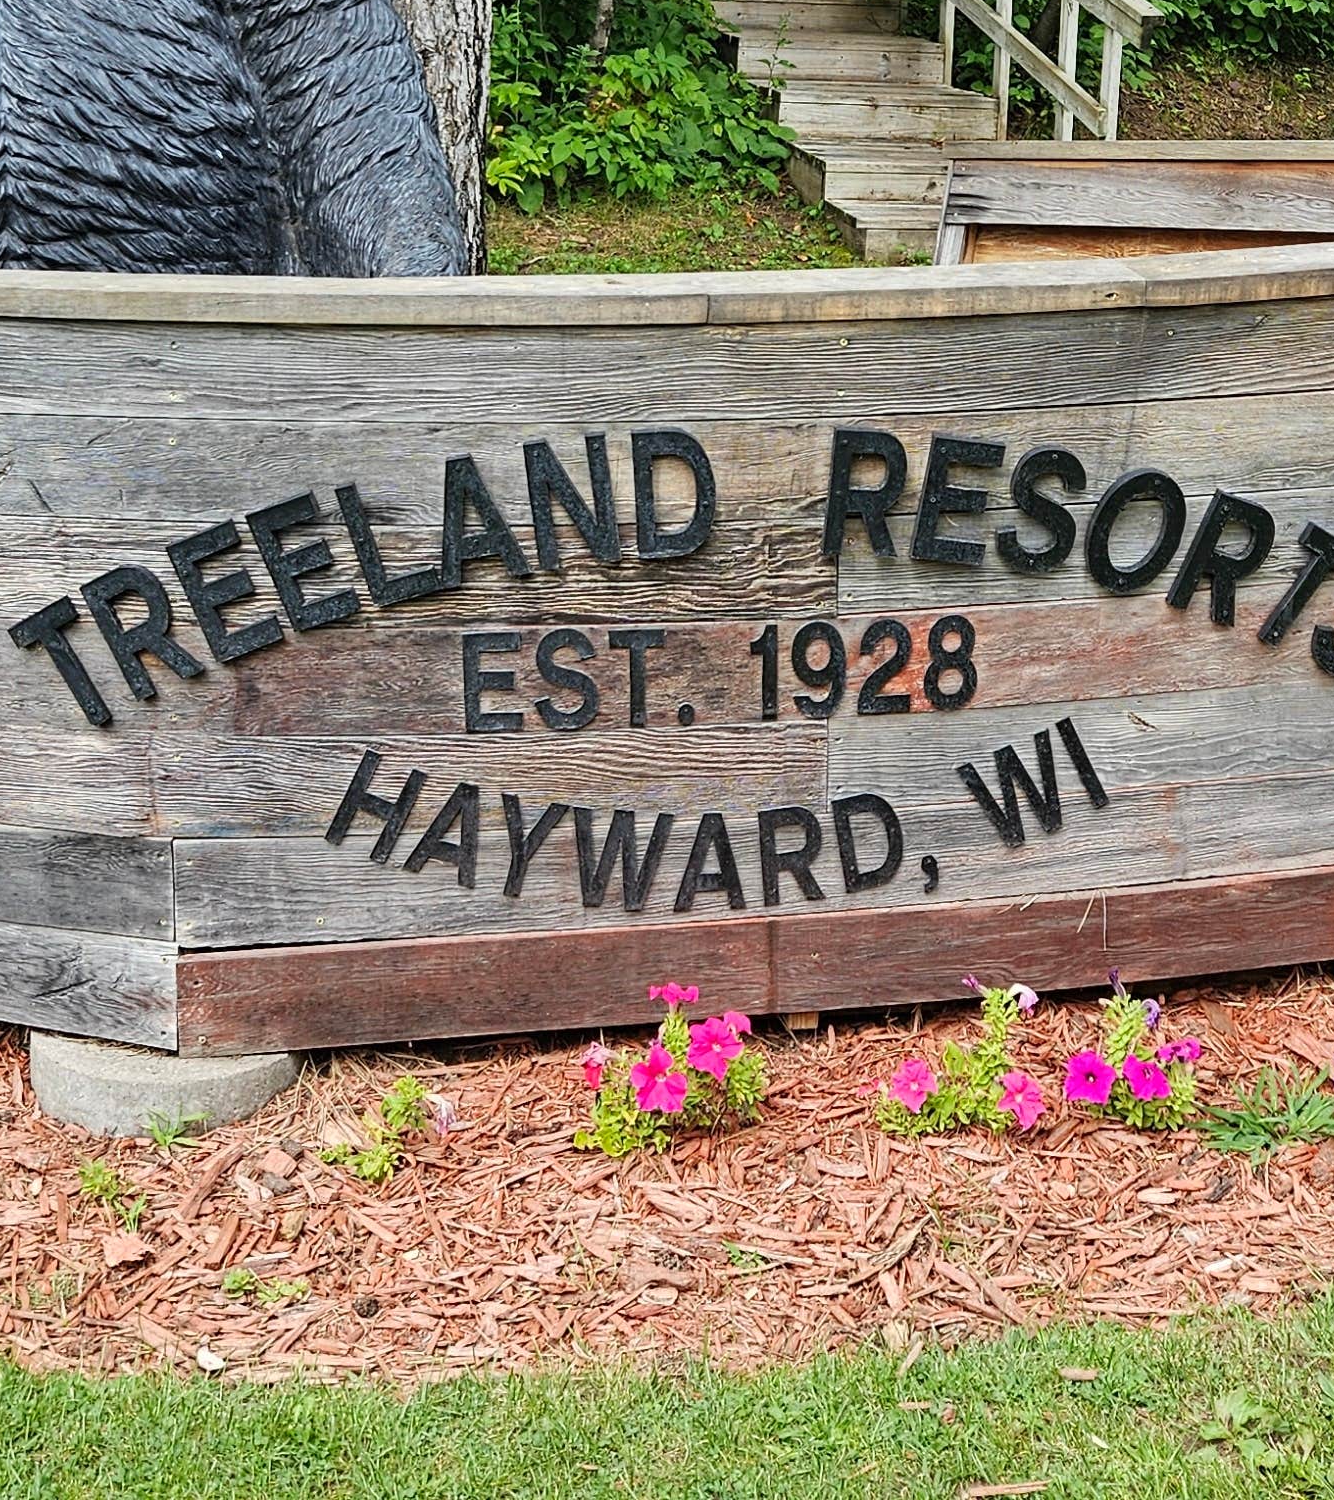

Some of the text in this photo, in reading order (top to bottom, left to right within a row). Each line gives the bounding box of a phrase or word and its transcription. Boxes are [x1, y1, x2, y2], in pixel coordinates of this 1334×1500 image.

[7, 428, 716, 727] TREELAND
[462, 614, 977, 733] EST. 1928
[324, 717, 1109, 911] HAYWARD, WI
